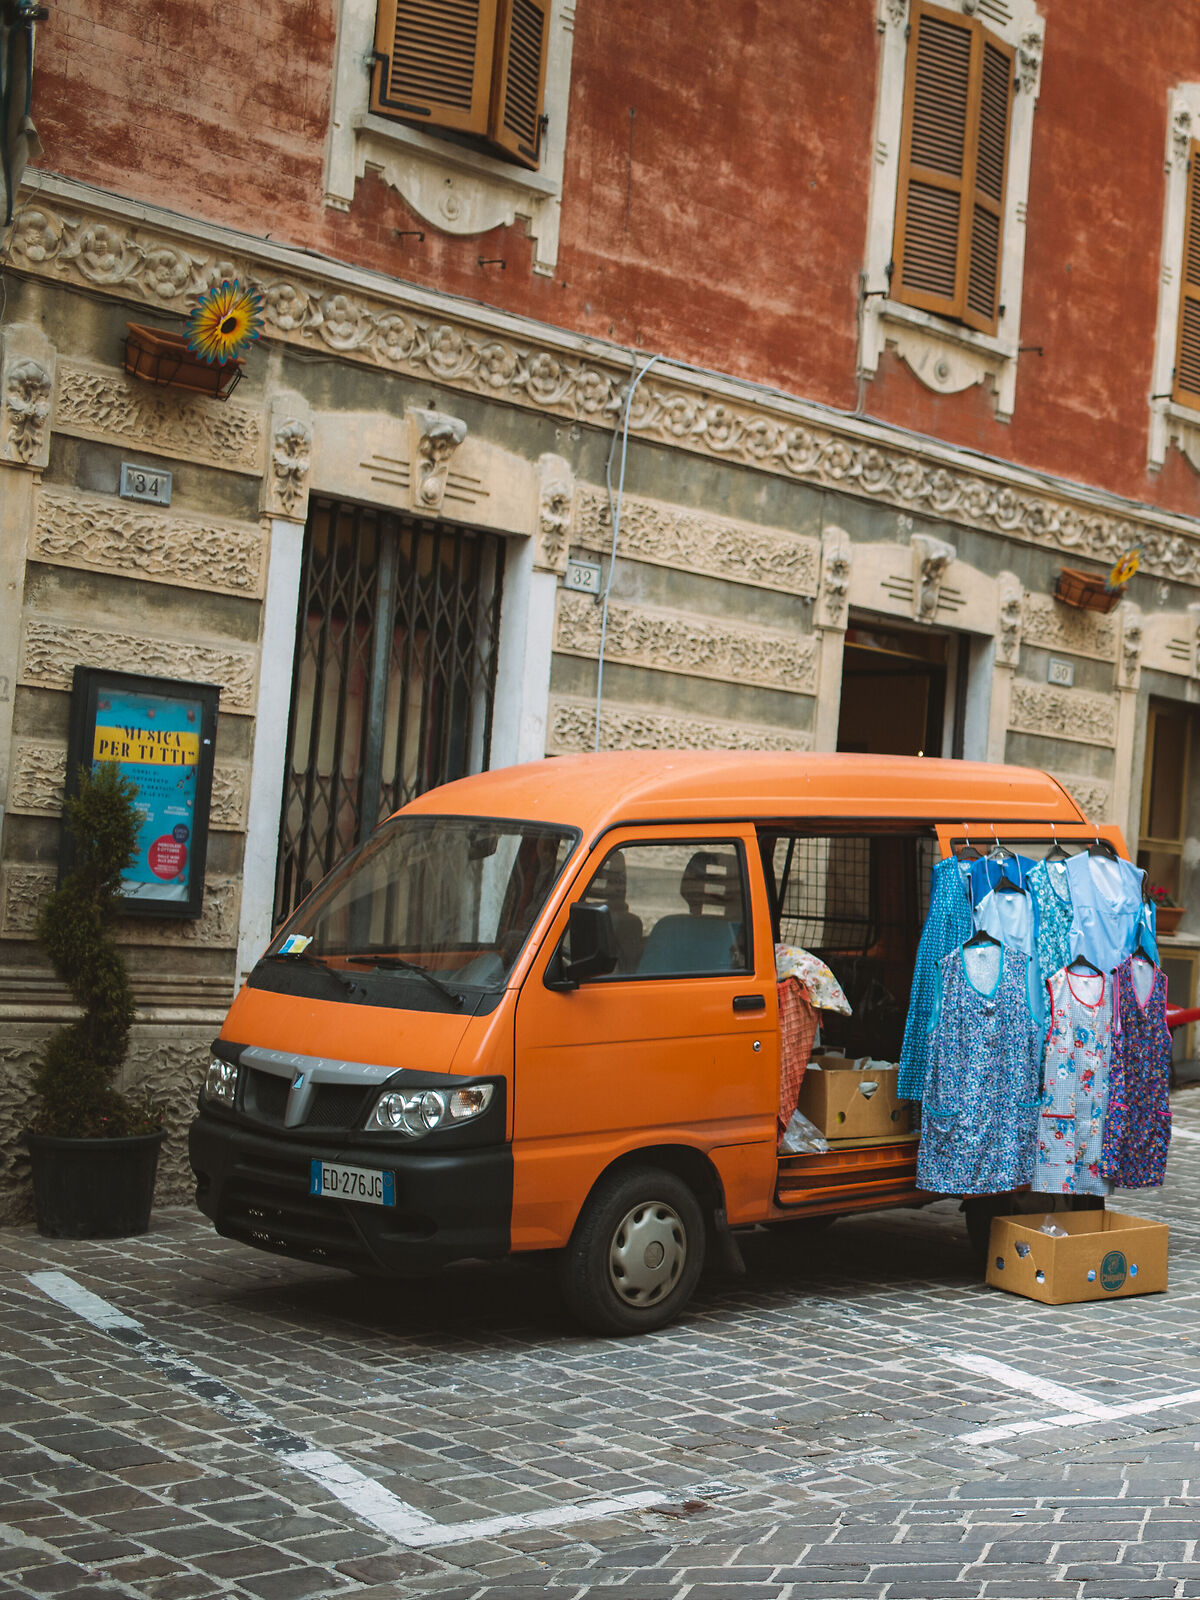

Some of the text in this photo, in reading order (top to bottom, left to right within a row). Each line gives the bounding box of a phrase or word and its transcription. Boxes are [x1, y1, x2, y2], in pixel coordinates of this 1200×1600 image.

[135, 474, 159, 496] 34
[574, 568, 592, 586] 32
[1054, 665, 1068, 681] 30
[99, 740, 130, 757] PER
